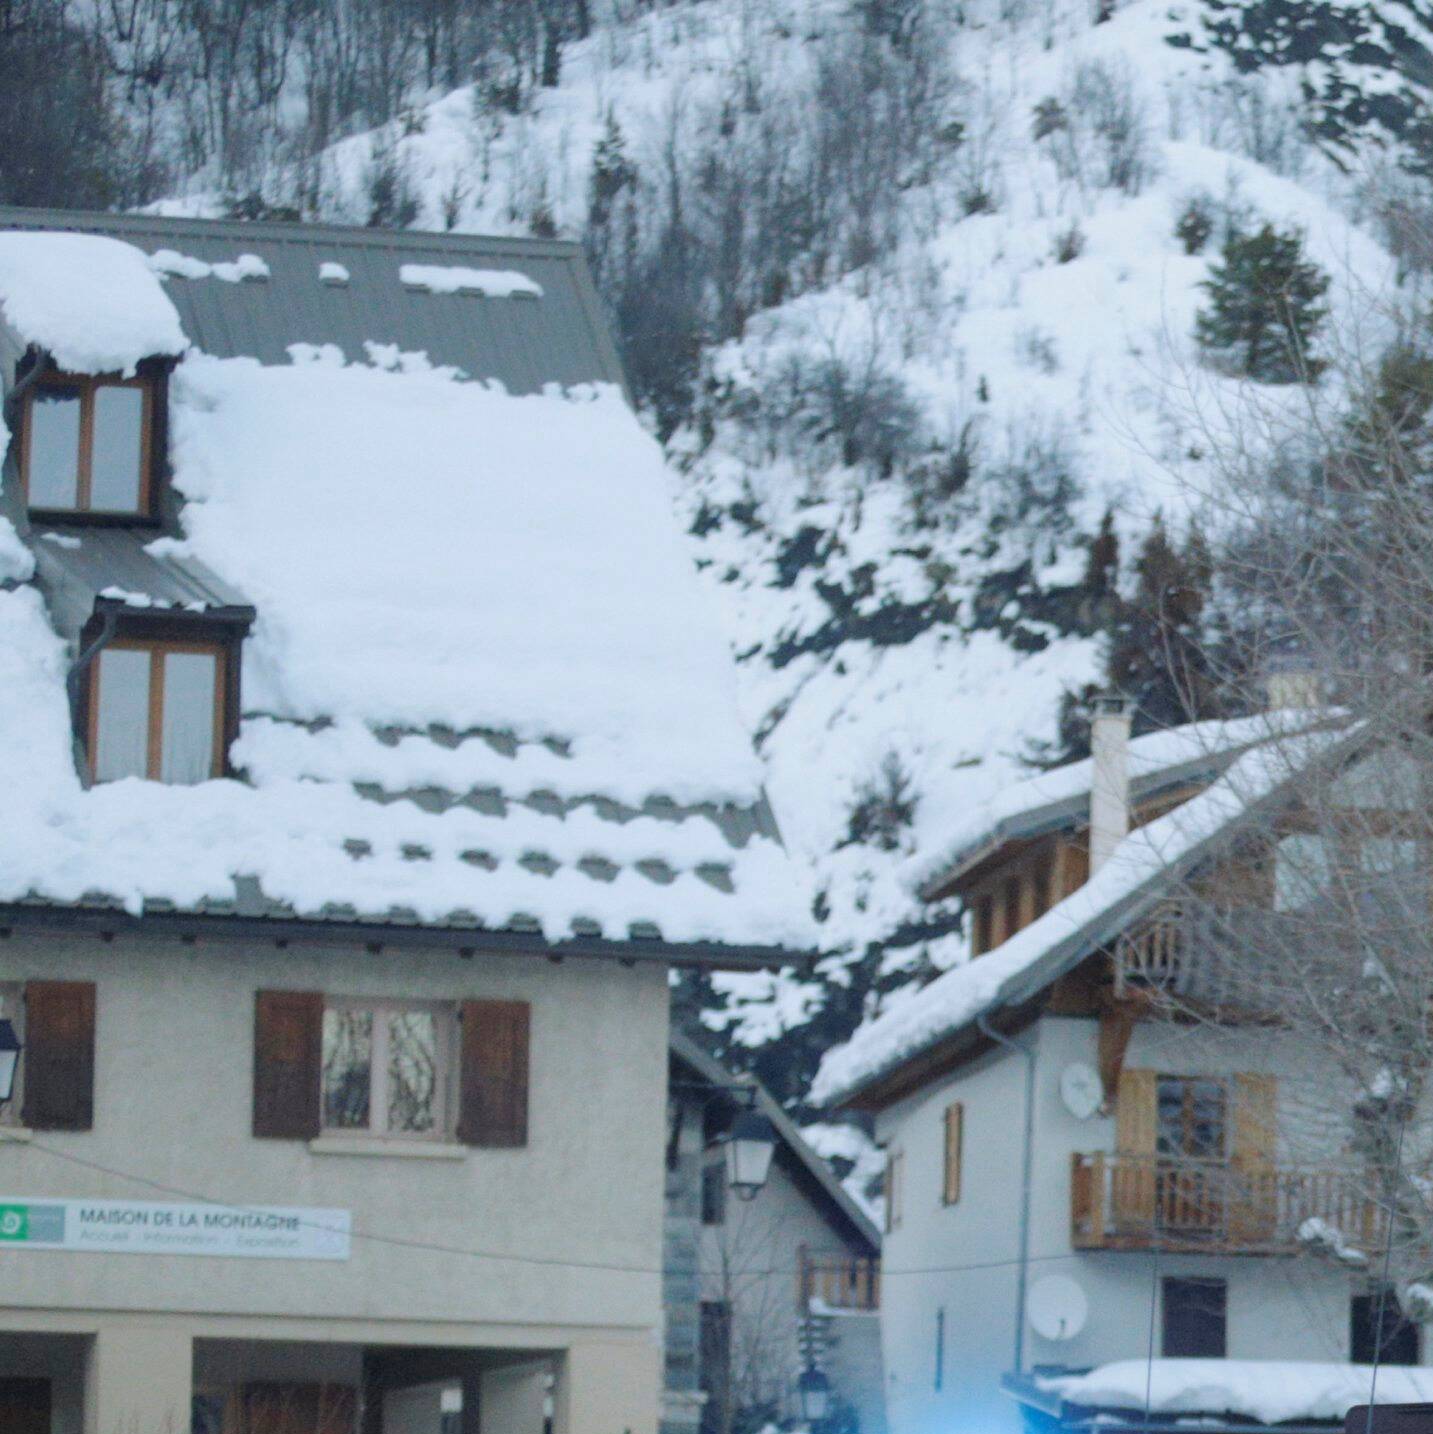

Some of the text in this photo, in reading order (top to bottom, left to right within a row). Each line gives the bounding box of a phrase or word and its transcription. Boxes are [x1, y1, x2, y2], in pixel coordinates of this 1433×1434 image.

[79, 1208, 148, 1225] MAISON
[153, 1210, 173, 1228] DE
[179, 1212, 197, 1228] LA
[202, 1212, 300, 1231] MONTAGNE
